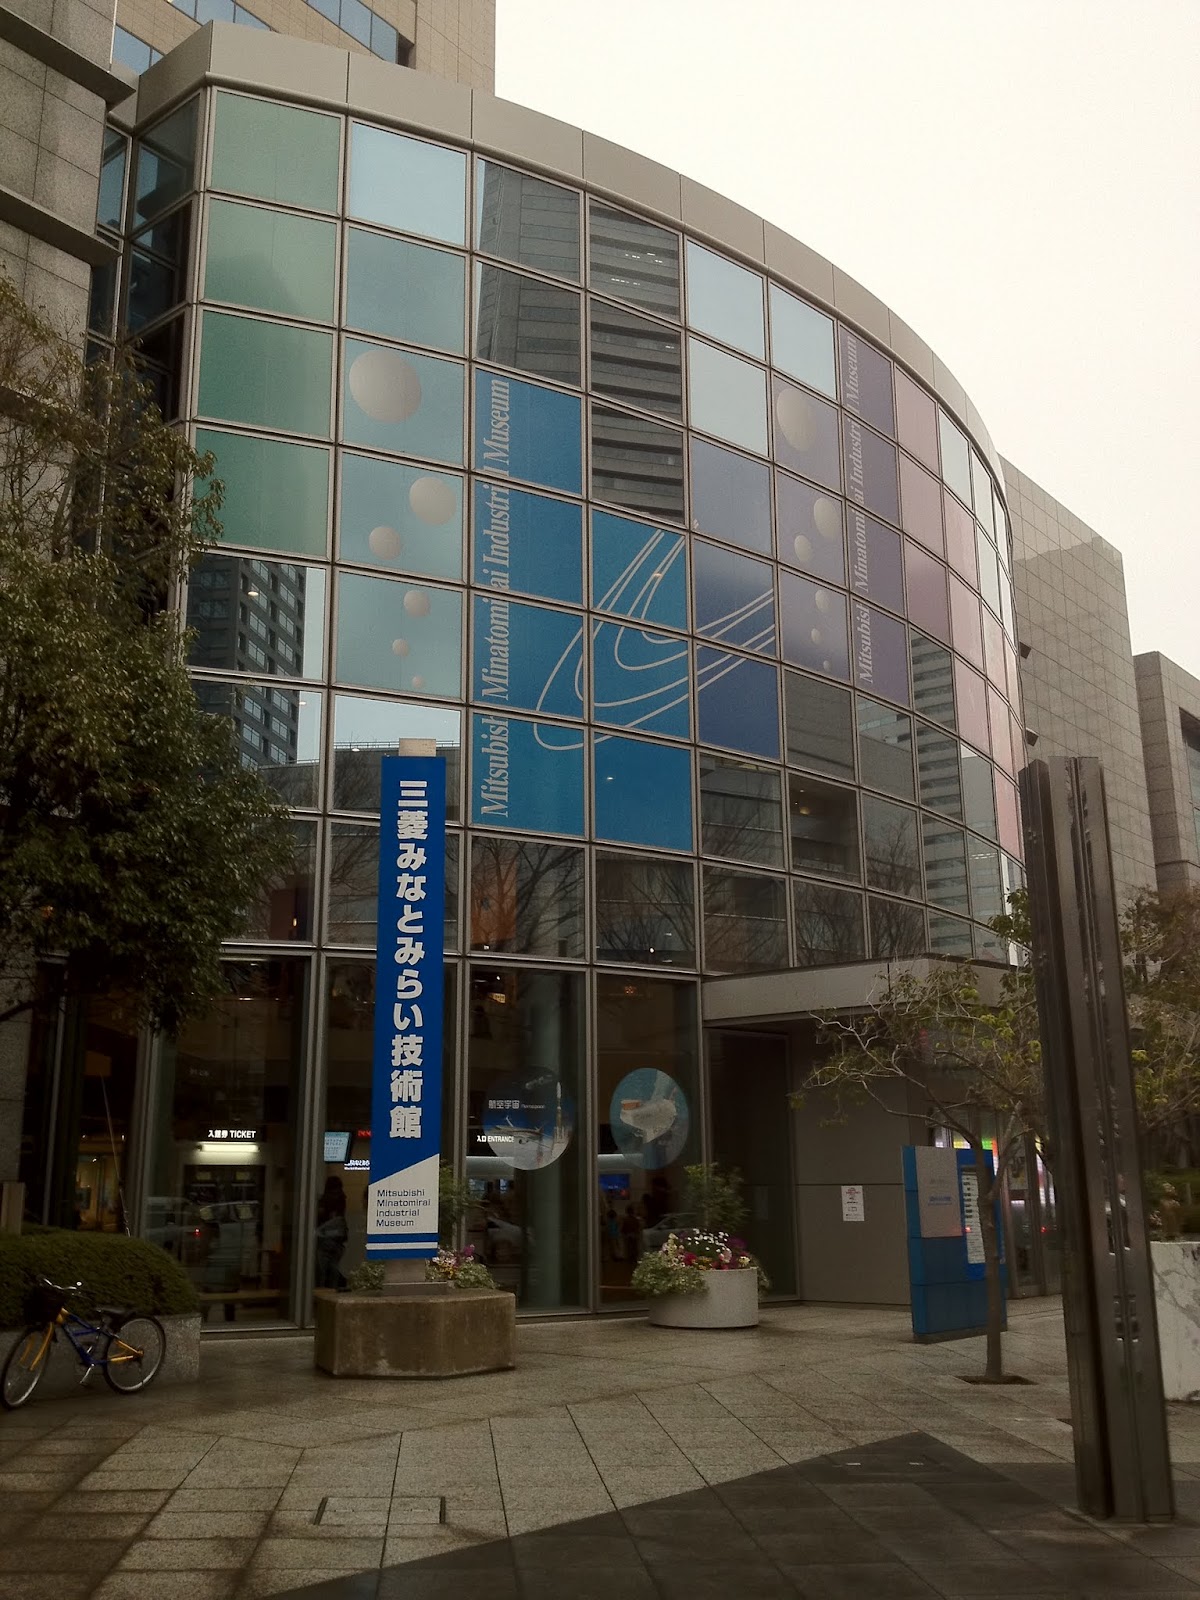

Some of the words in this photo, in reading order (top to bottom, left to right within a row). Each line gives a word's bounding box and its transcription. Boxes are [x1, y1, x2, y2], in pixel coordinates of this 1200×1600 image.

[845, 335, 860, 405] Museum
[483, 379, 510, 465] Museum
[482, 465, 511, 568] Industril
[850, 485, 869, 593] Minatomiai
[481, 568, 511, 701] Minatomiai
[389, 780, 429, 1139] 三菱みなとみらい技術館
[488, 1099, 520, 1109] 航空宇宙
[229, 1130, 257, 1139] TICKET
[476, 1135, 487, 1143] 入口
[487, 1135, 515, 1143] ENTRANCE
[377, 1188, 425, 1197] Mitsubishi
[376, 1199, 431, 1207] Minatomirai
[376, 1208, 420, 1217] Industrial
[376, 1219, 414, 1227] Museum
